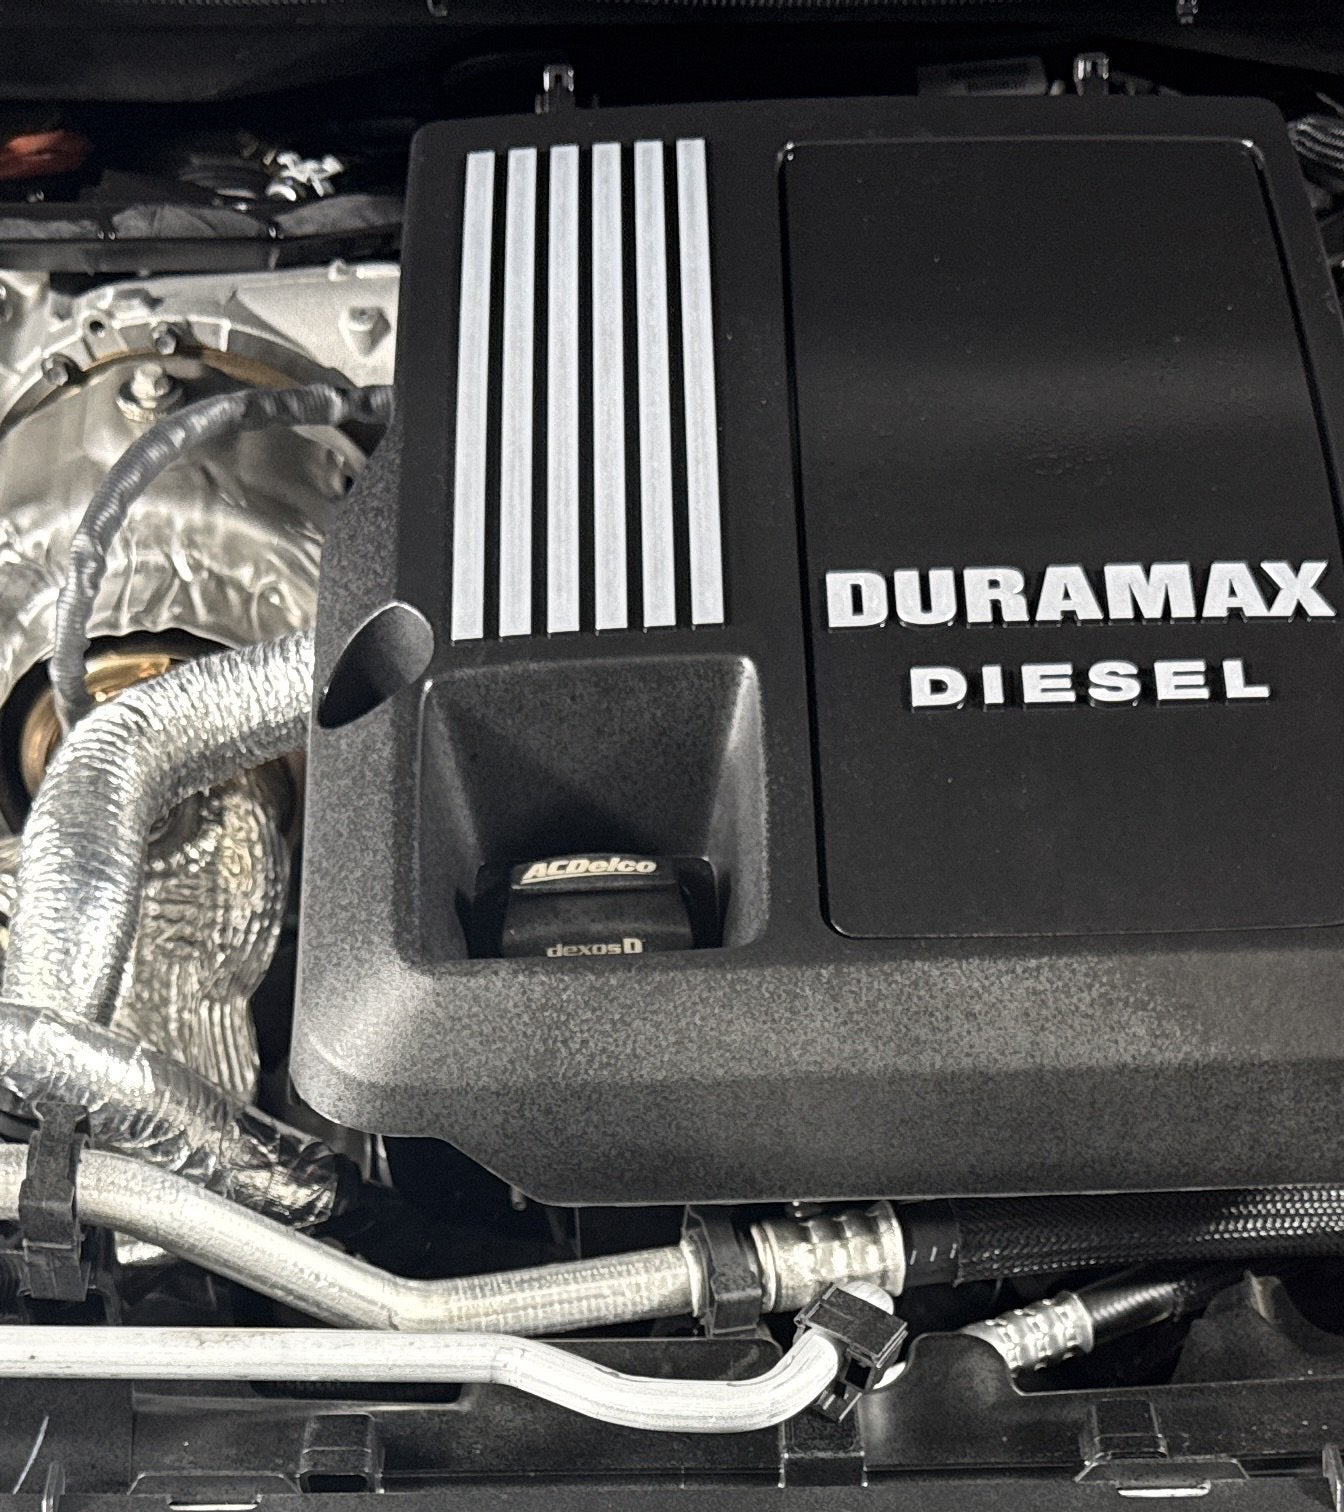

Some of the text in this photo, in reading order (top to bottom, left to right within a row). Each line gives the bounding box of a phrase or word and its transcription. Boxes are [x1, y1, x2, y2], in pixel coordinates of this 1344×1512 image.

[825, 560, 1338, 630] DURAMAX
[909, 658, 1271, 709] DIESEL
[522, 857, 657, 880] ACDelco
